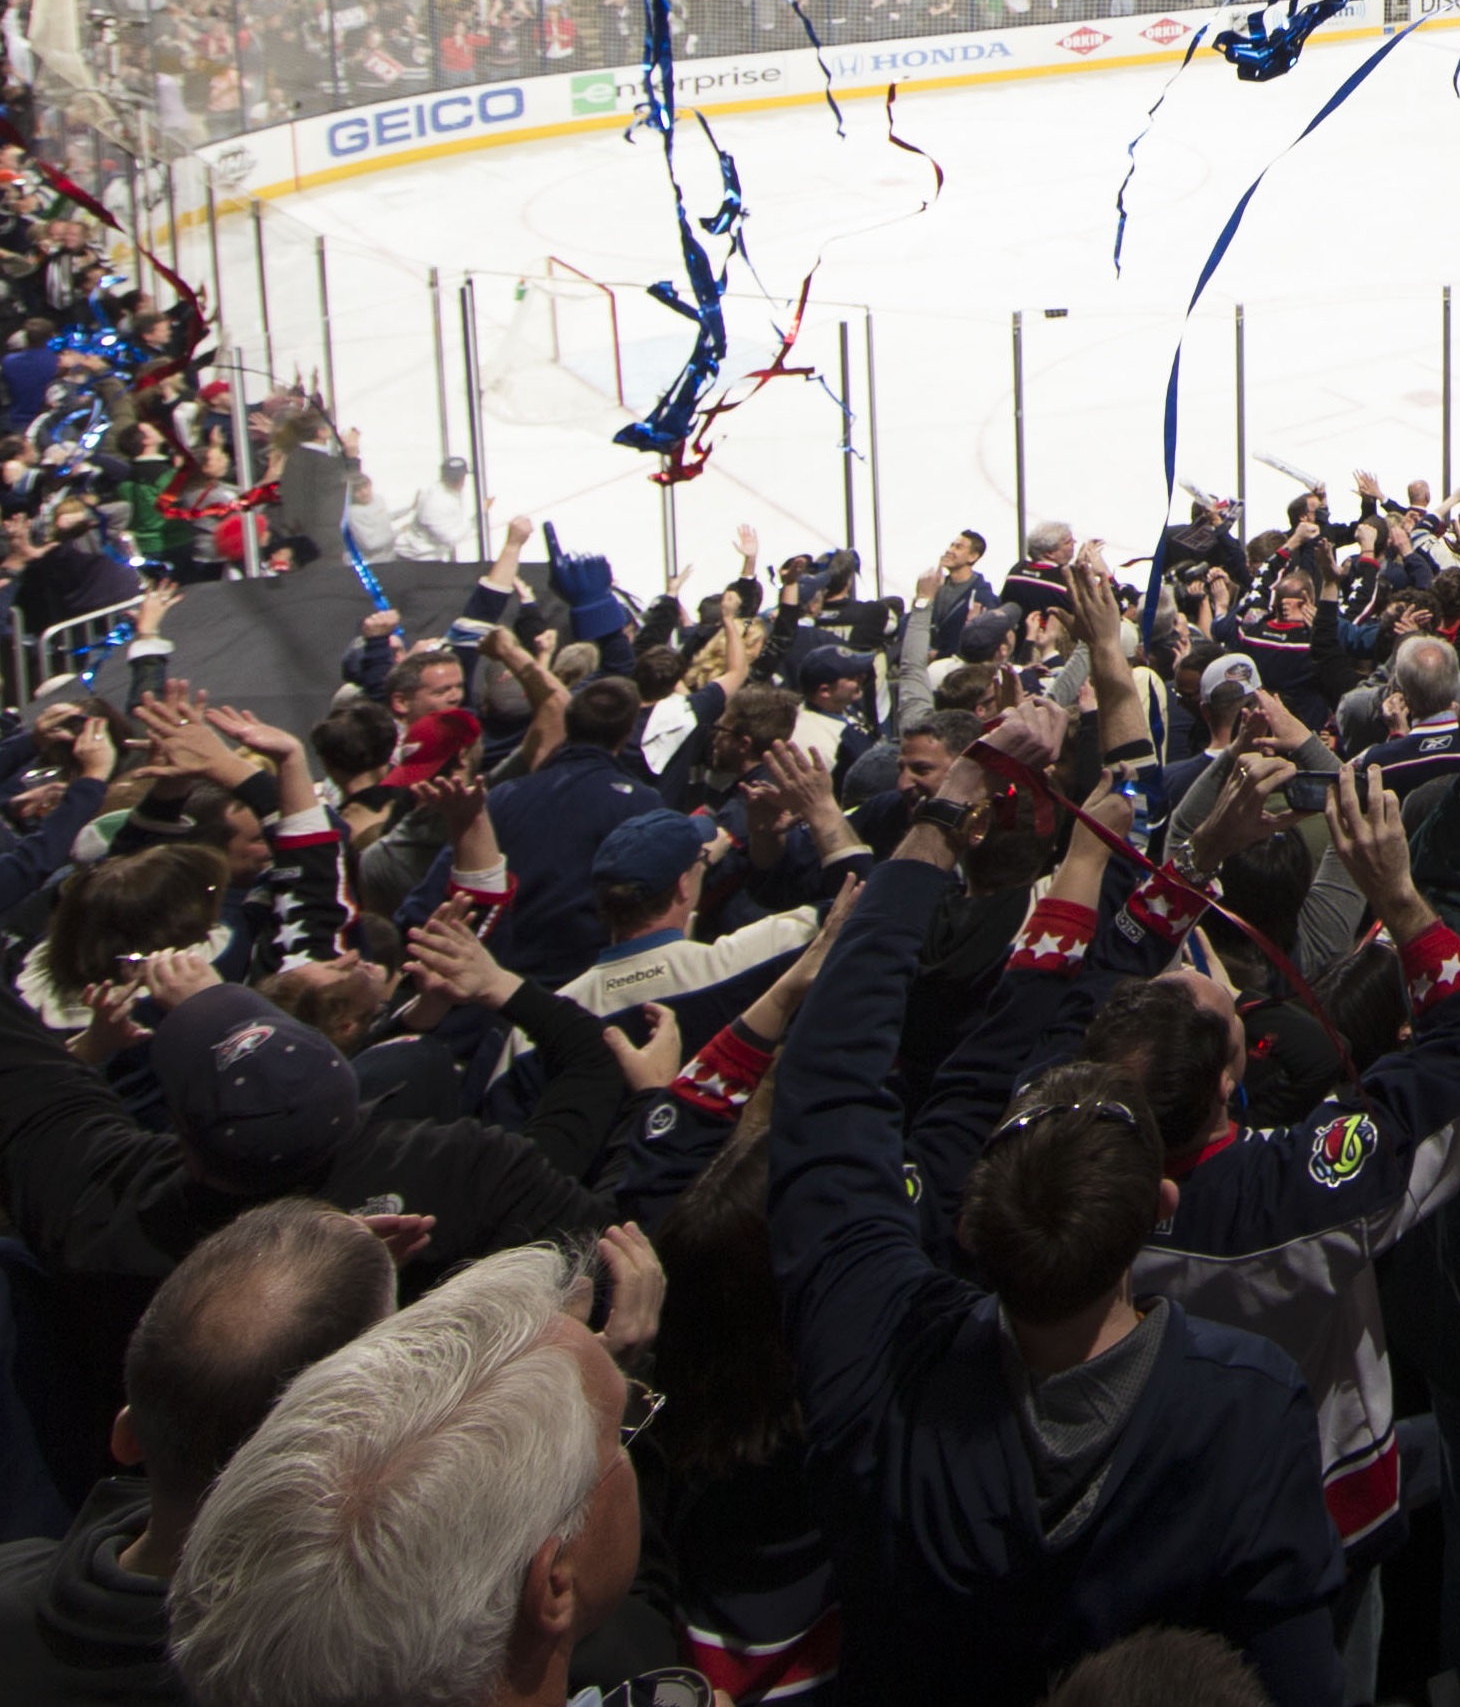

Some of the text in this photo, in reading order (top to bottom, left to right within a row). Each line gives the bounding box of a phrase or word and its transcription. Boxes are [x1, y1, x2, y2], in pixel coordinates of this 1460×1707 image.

[1062, 33, 1105, 50] ORKIN
[1144, 25, 1182, 41] ORKIN
[871, 41, 1013, 72] HONDA
[584, 66, 782, 106] enrprise
[327, 87, 525, 158] GEICO
[606, 964, 667, 992] Reebok
